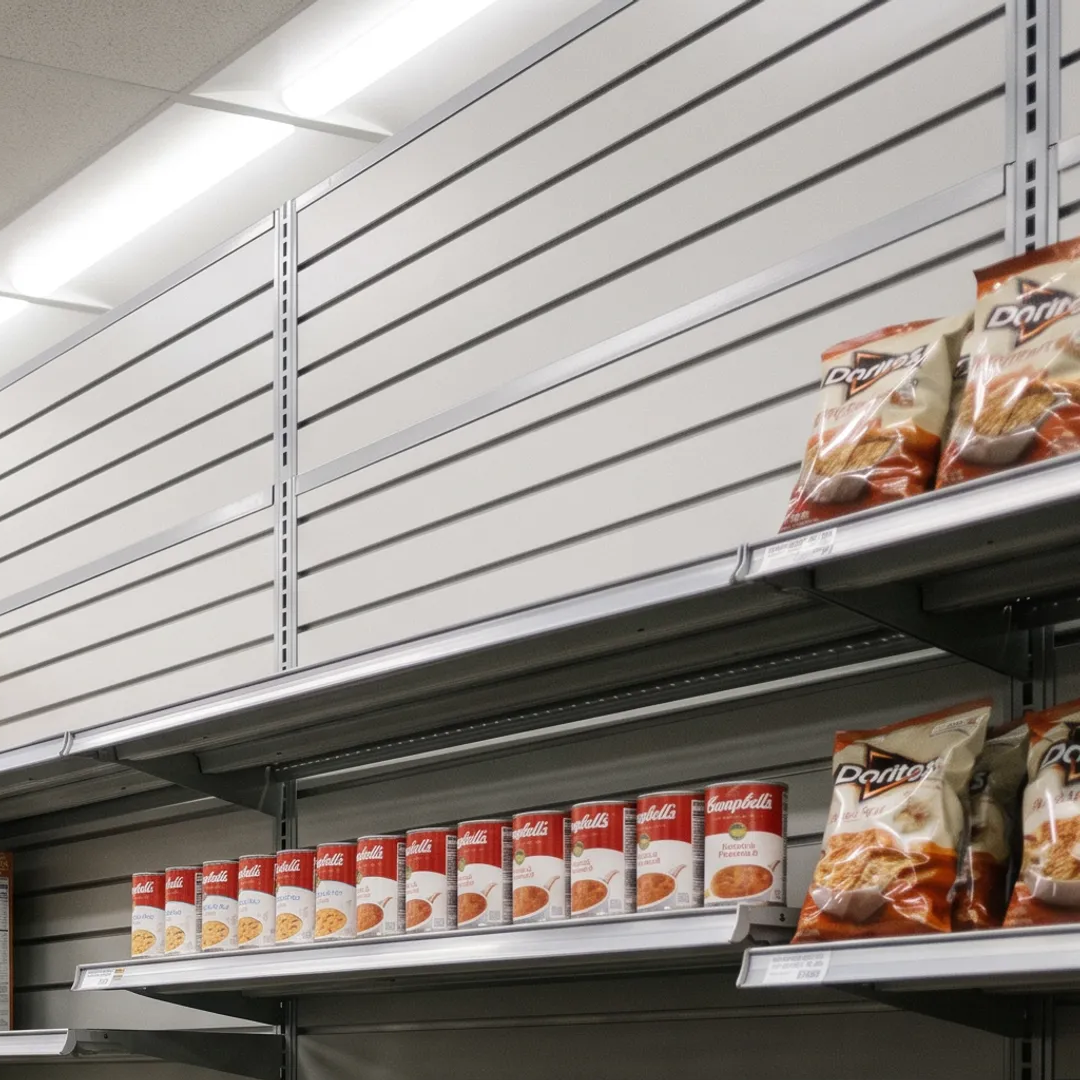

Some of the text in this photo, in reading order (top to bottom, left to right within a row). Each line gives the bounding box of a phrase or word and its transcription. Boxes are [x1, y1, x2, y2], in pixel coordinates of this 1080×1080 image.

[823, 346, 929, 387] Doritos
[1040, 743, 1080, 770] Do
[835, 757, 946, 787] Doritos
